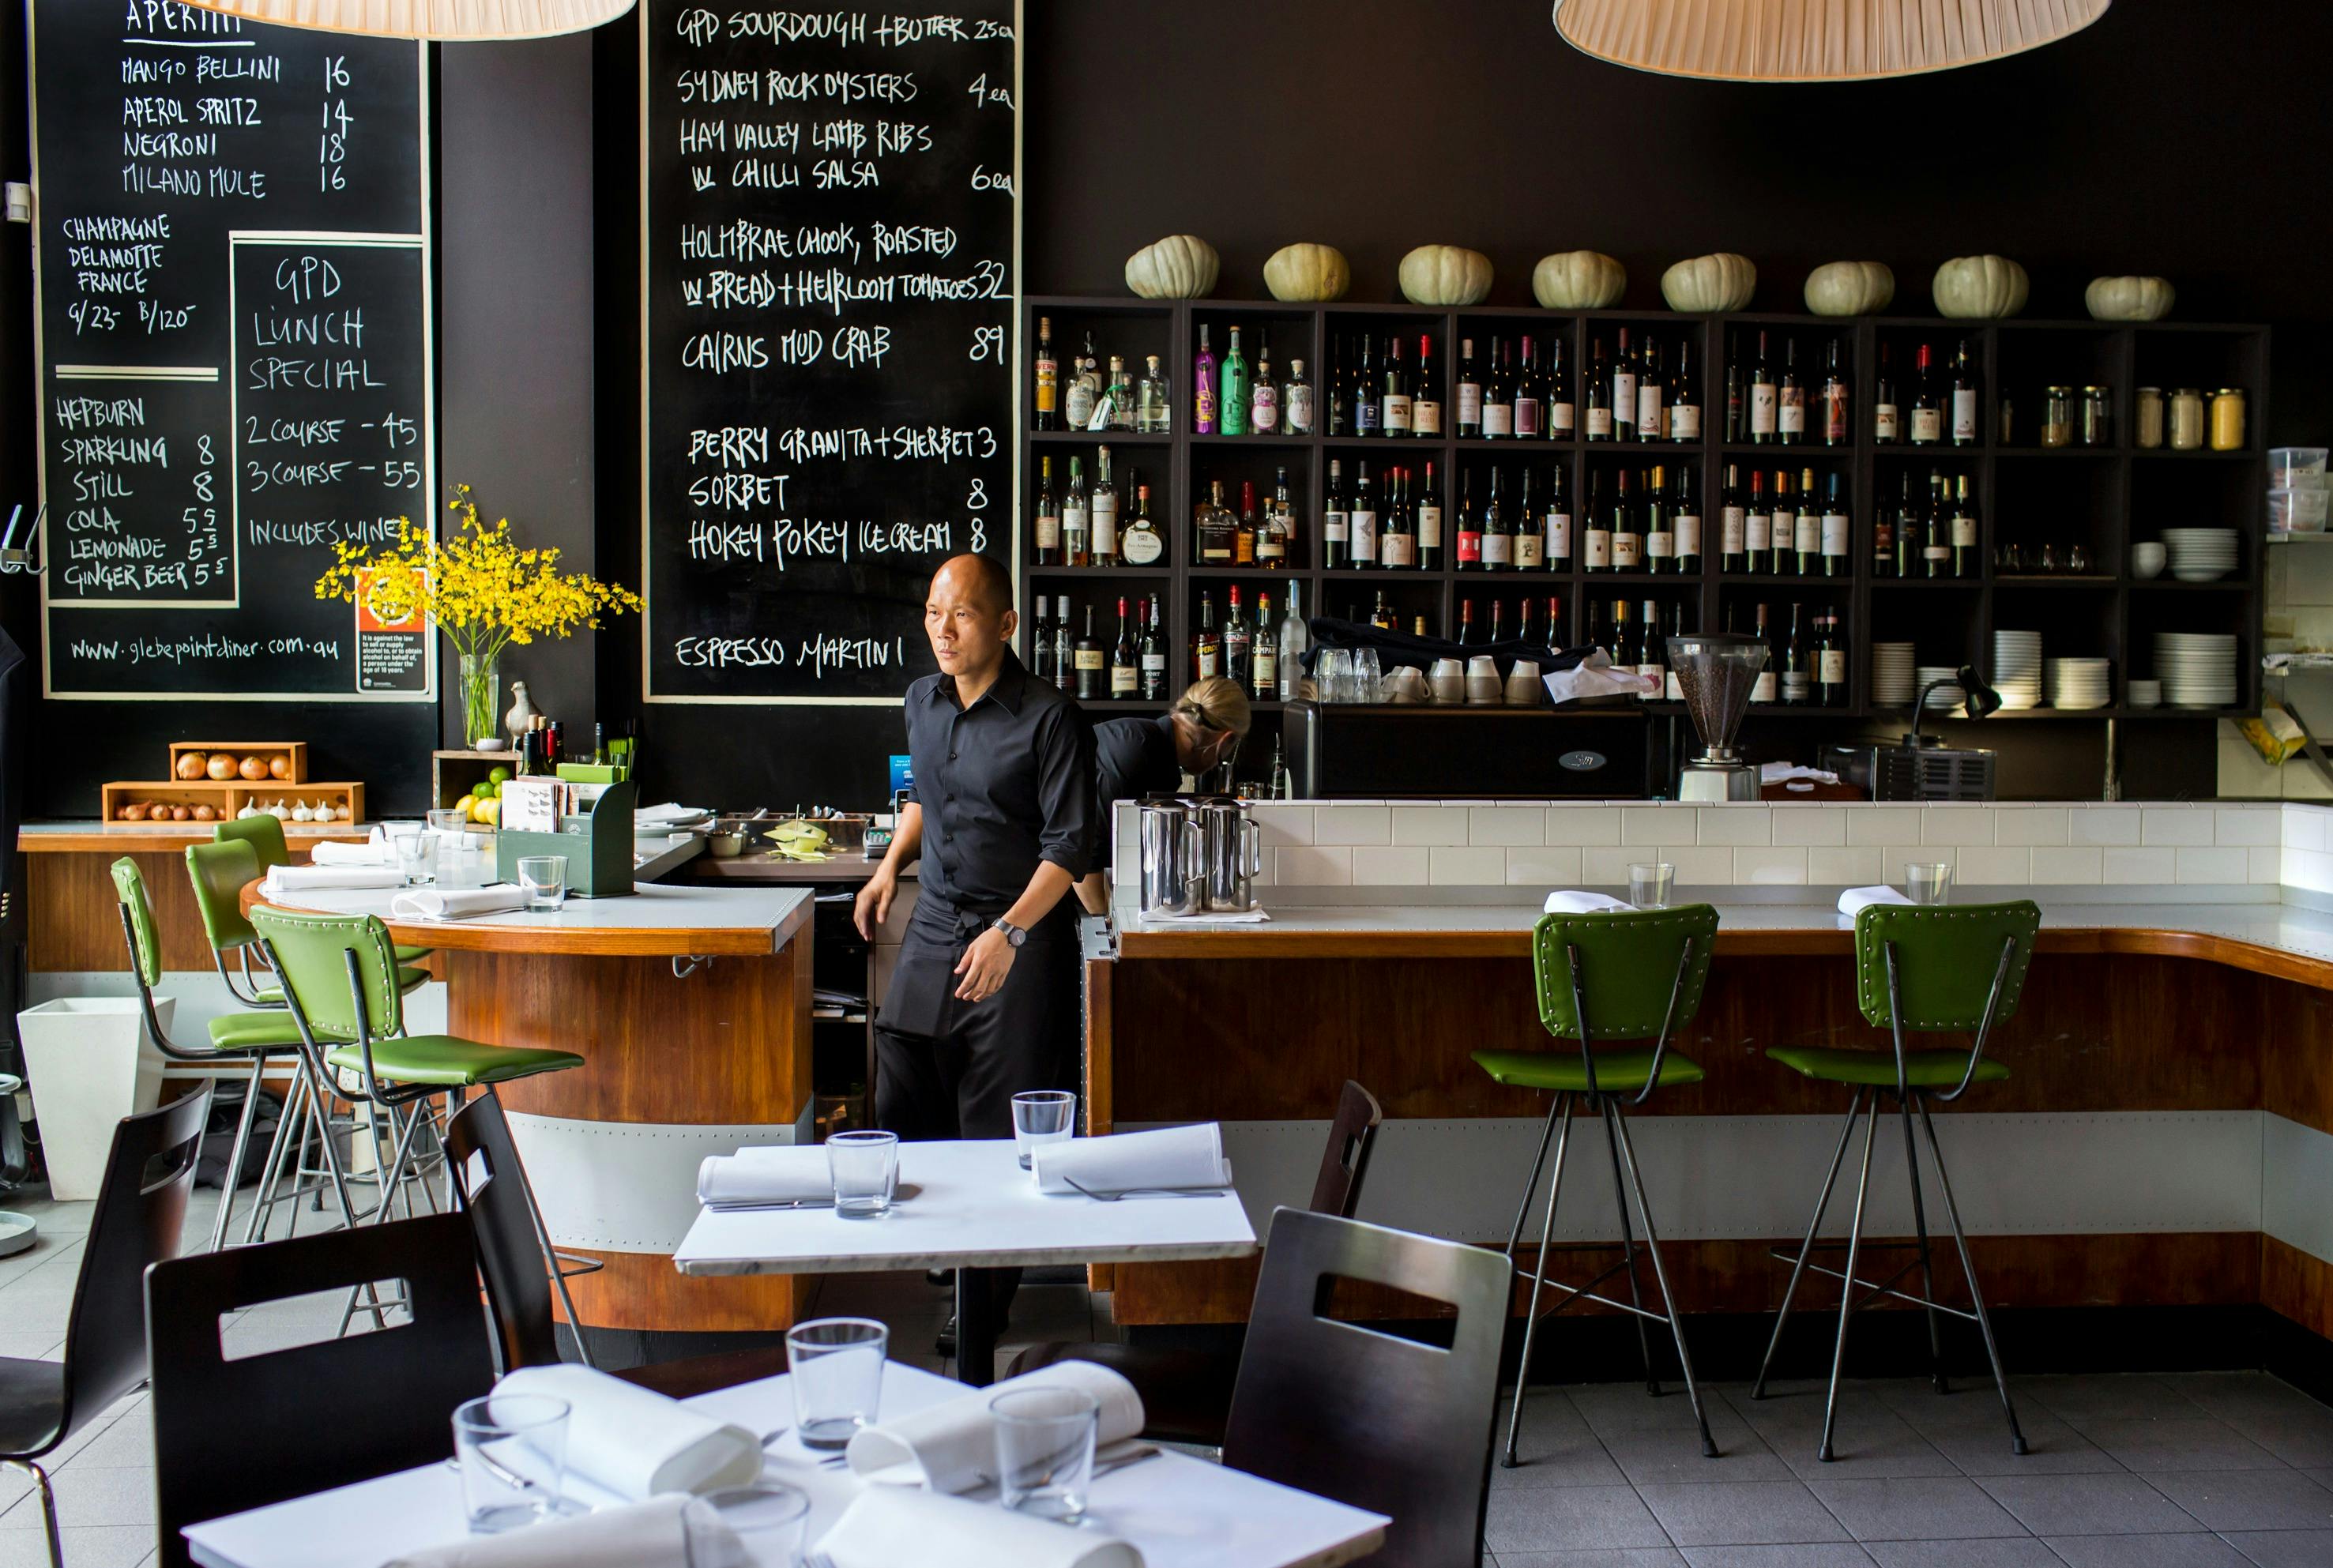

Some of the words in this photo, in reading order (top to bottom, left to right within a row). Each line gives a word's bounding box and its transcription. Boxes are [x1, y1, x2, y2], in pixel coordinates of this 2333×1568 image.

[676, 8, 720, 47] GPD
[728, 10, 867, 48] SOURDOUGH
[122, 56, 186, 85] MANGO
[195, 55, 280, 85] BELLINI
[325, 55, 351, 94] 16
[677, 70, 758, 103] SYDNEY
[766, 68, 819, 106] ROCK
[824, 70, 917, 105] OYSTERS
[123, 96, 189, 128] APEROL
[195, 97, 262, 126] SPRITZ
[322, 99, 355, 140] 14
[124, 131, 216, 159] NEGRONI
[320, 131, 347, 164] 18
[679, 118, 725, 155] HAY
[734, 121, 800, 155] VALLEY
[812, 118, 867, 159] LAMB
[875, 119, 932, 157] RIBS
[122, 163, 201, 196] MILANO
[209, 165, 266, 199] MULE
[321, 165, 346, 193] 16
[732, 158, 800, 189] CHILLI
[811, 160, 879, 190] SALSA
[62, 213, 171, 241] CHAMPAGNE
[871, 220, 957, 262] ROASTED
[68, 243, 164, 269] DELAMOTTE
[77, 268, 148, 295] FRANCE
[276, 255, 341, 305] GPD
[977, 259, 1014, 300] 32
[254, 305, 364, 349] LUNCH
[682, 330, 770, 375] CAIRNS
[781, 329, 823, 366] MUD
[831, 325, 891, 369] CRAB
[969, 325, 1004, 365] 89
[249, 356, 386, 391] SPECIAL
[56, 396, 145, 431] HEPBURN
[246, 416, 268, 444] 2
[270, 418, 346, 446] COURSE
[382, 412, 417, 449] 45
[61, 434, 167, 468] SPARKLING
[197, 434, 215, 465] 8
[687, 427, 768, 469] BERRY
[977, 427, 997, 458] 3
[73, 470, 134, 502] STILL
[192, 470, 214, 502] 8
[246, 461, 269, 492] 3
[272, 461, 352, 487] COURSE
[383, 461, 421, 489] 55
[688, 472, 790, 511] SORBET
[966, 478, 988, 510] 8
[66, 506, 121, 535] COLA
[250, 519, 340, 546] INCLUDES
[345, 517, 401, 545] WINE
[70, 534, 167, 560] LEMONADE
[687, 519, 763, 562] HOKEY
[772, 517, 848, 572] POKEY
[970, 517, 987, 554] 8
[64, 560, 141, 596] GINGER
[144, 562, 189, 590] BEER
[675, 636, 785, 667] ESPRESSO
[796, 633, 904, 679] MARTINI
